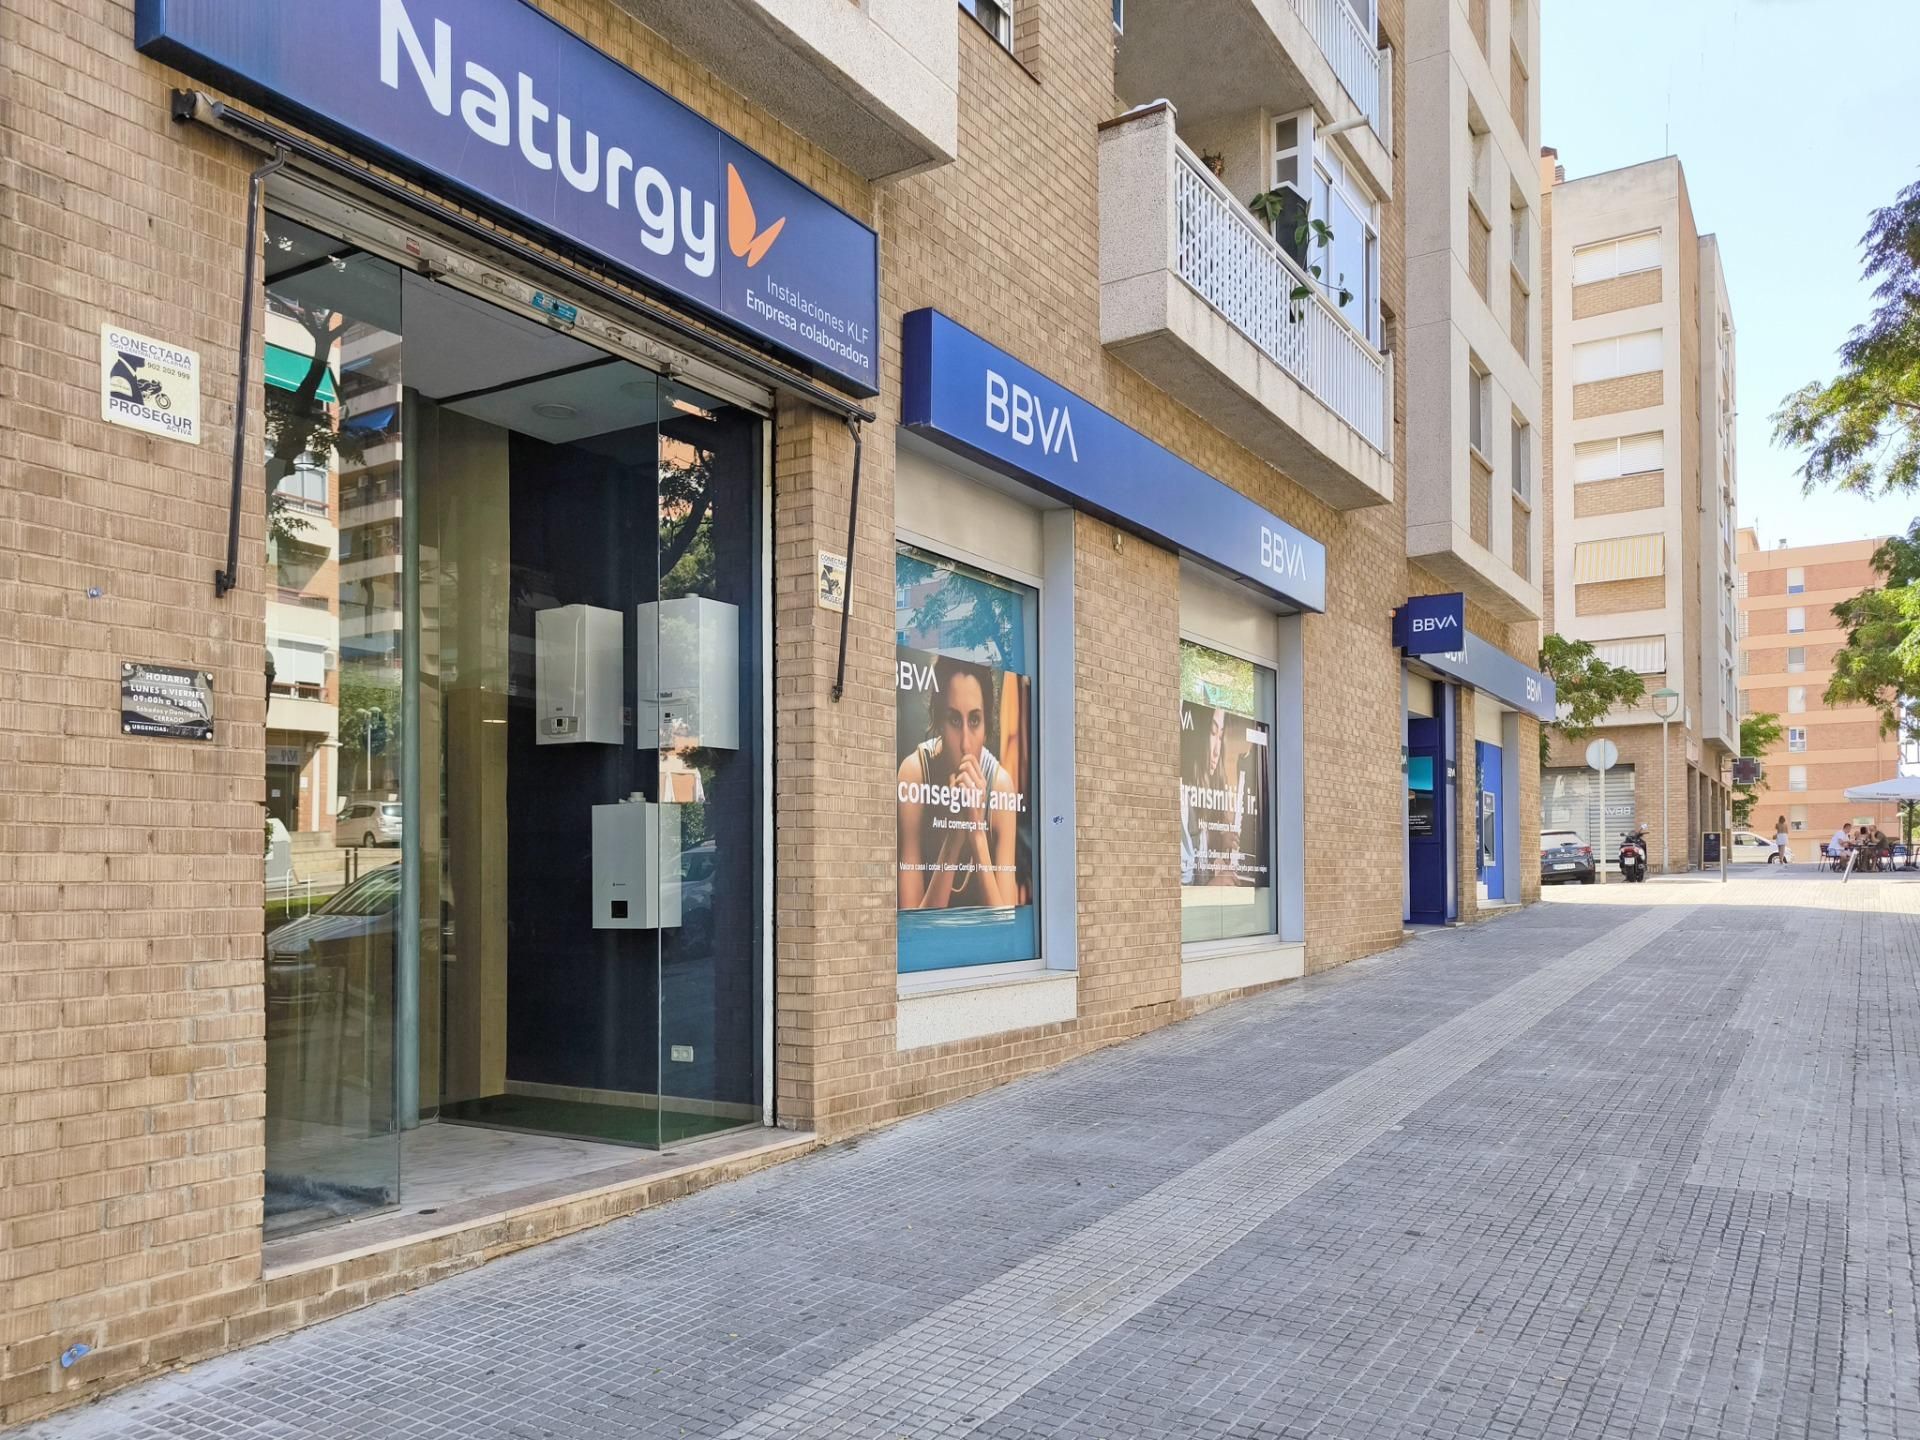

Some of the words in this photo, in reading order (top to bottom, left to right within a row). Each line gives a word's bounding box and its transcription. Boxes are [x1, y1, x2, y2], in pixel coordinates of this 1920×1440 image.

[380, 0, 715, 277] Naturgy
[767, 274, 844, 333] Instalaciones
[847, 320, 869, 344] KLF
[746, 288, 797, 332] Empresa
[800, 323, 869, 369] colaboradora
[109, 333, 192, 366] CONECTADA
[109, 398, 192, 430] PROSEGUR
[985, 369, 1078, 463] BBVA
[166, 425, 192, 436] ACTIVA
[1260, 526, 1306, 581] BBVA
[1413, 614, 1458, 632] BBVA
[130, 684, 160, 694] LUNES
[169, 688, 205, 699] VIERNES
[146, 672, 191, 684] HORARIO
[896, 660, 940, 693] BVA
[1526, 676, 1543, 703] BBVA
[897, 781, 986, 813] conseguir.
[989, 790, 1026, 813] anar.
